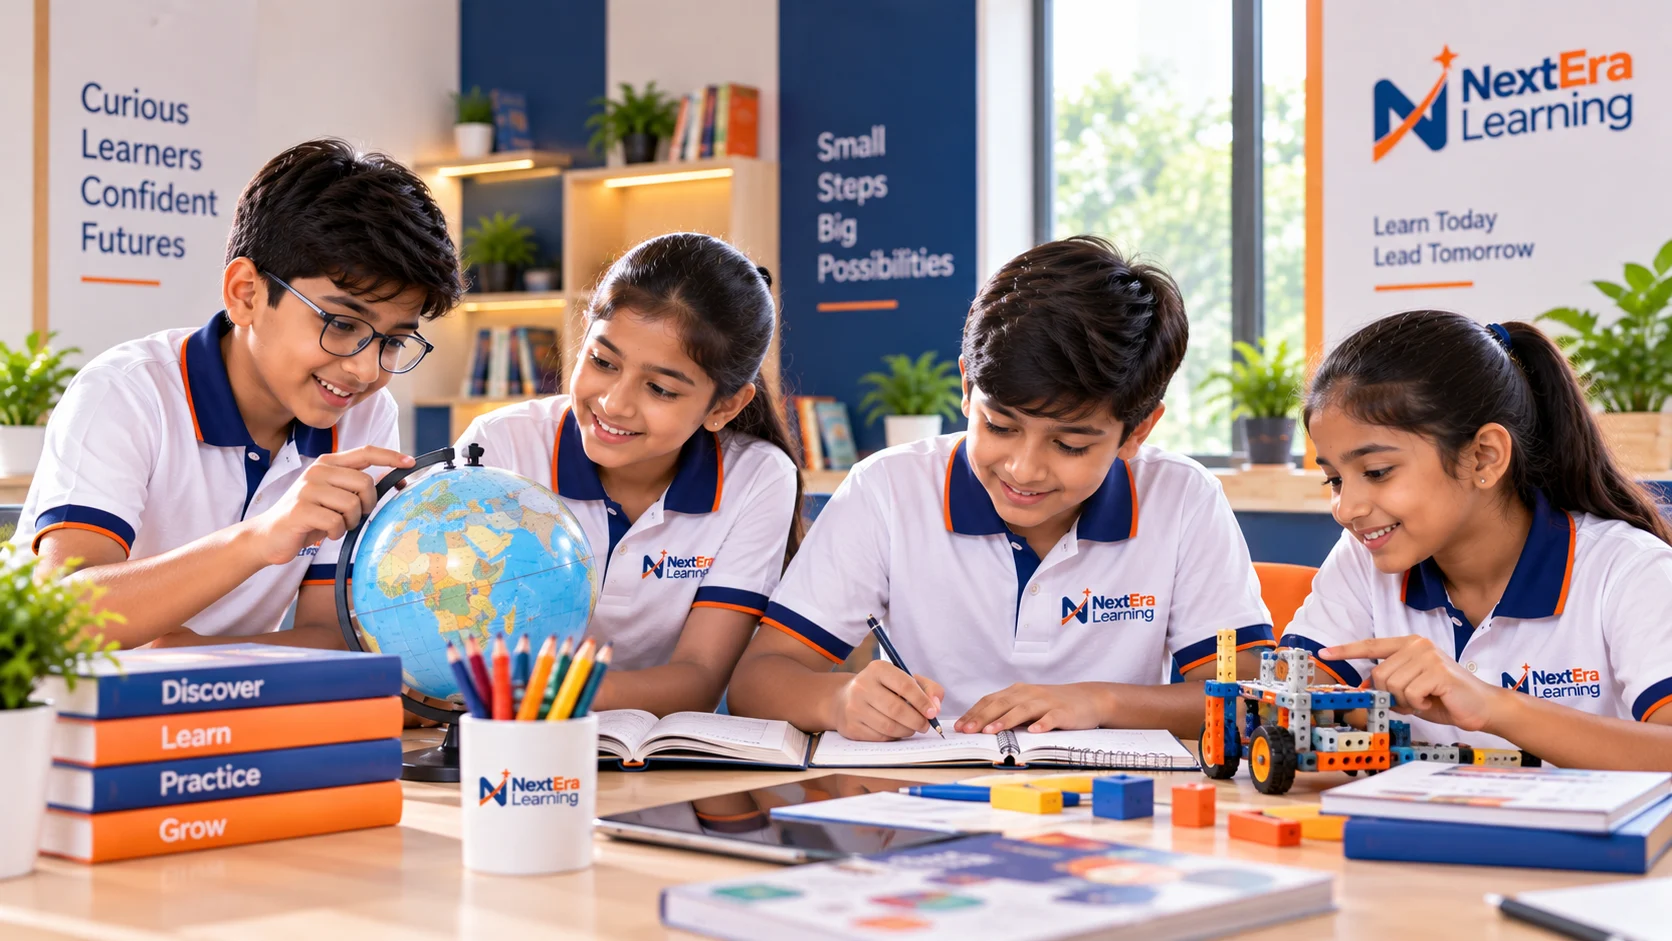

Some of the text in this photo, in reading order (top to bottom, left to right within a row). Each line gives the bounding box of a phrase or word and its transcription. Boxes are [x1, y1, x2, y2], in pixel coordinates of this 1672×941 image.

[1462, 49, 1633, 103] NextEra
[81, 82, 190, 125] Curious
[1462, 91, 1633, 141] Learning
[82, 128, 202, 171] Learners
[817, 124, 886, 162] Small
[81, 175, 218, 217] Confident
[817, 171, 888, 206] Steps
[818, 212, 858, 248] Big
[1373, 209, 1498, 236] Learn Today
[82, 222, 185, 258] Futures
[1373, 241, 1535, 267] Lead Tomorrow
[818, 246, 955, 284] Possibilities
[1092, 594, 1155, 609] NextEra
[1092, 608, 1155, 623] Learning
[161, 677, 265, 705] Discover
[1532, 668, 1599, 685] NextEra
[1534, 683, 1600, 698] Learning
[161, 725, 232, 750] Learn
[160, 763, 262, 797] Practice
[512, 776, 580, 792] NextEra
[512, 791, 579, 807] Learning
[159, 817, 227, 843] Grow
